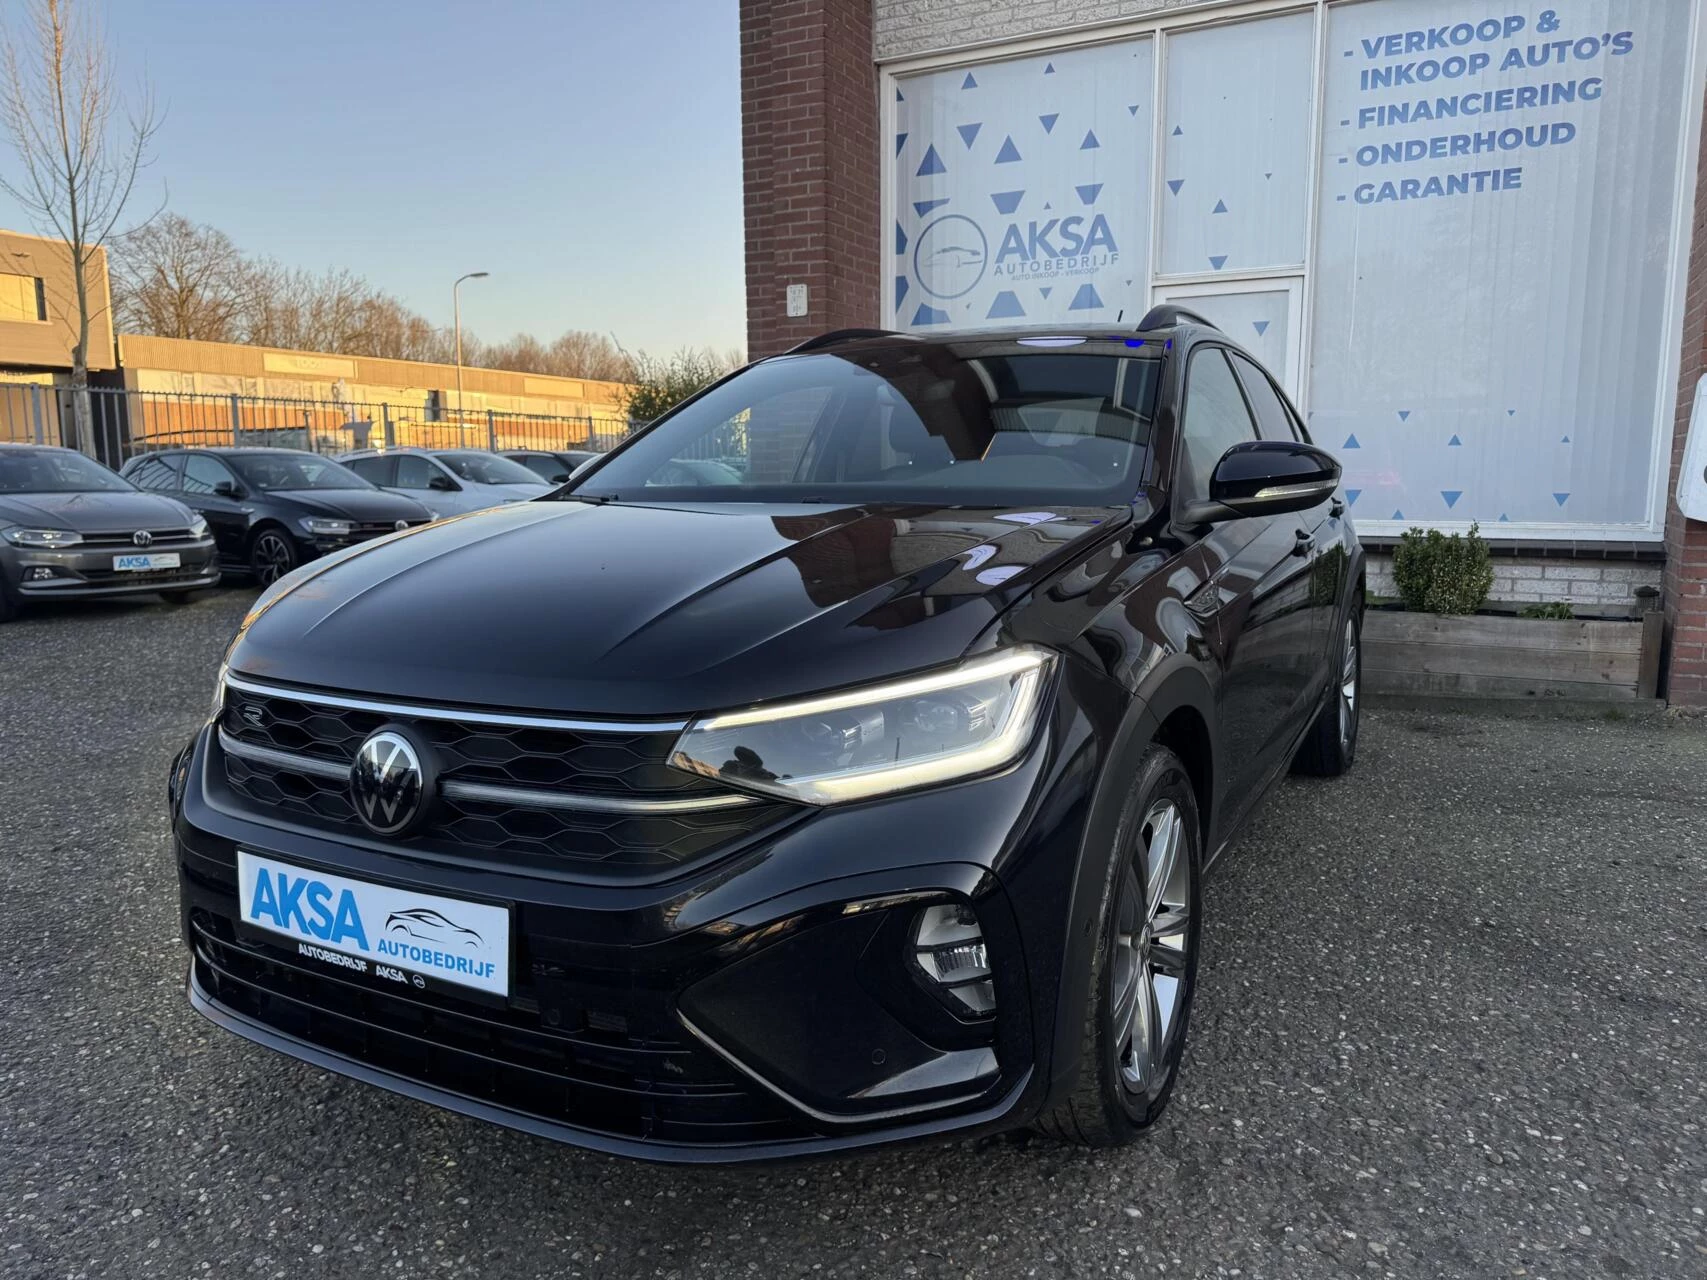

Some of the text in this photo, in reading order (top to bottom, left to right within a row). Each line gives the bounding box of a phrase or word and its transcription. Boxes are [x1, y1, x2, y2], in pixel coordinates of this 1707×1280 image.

[1361, 15, 1526, 59] VERKOOP
[1536, 10, 1560, 33] &
[1360, 52, 1490, 91] INKOOP
[1358, 77, 1603, 129] FINANCIERING
[1356, 122, 1576, 167] ONDERHOUD
[1354, 167, 1523, 205] GARANTIE
[995, 214, 1118, 263] AKSA
[994, 253, 1119, 276] AUTOBEDRIJF
[119, 556, 151, 568] AKSA
[250, 868, 370, 951] AKSA
[298, 943, 409, 984] AUTOBEDRIJF AKSA
[377, 939, 496, 979] AUTOBEDRIJF
